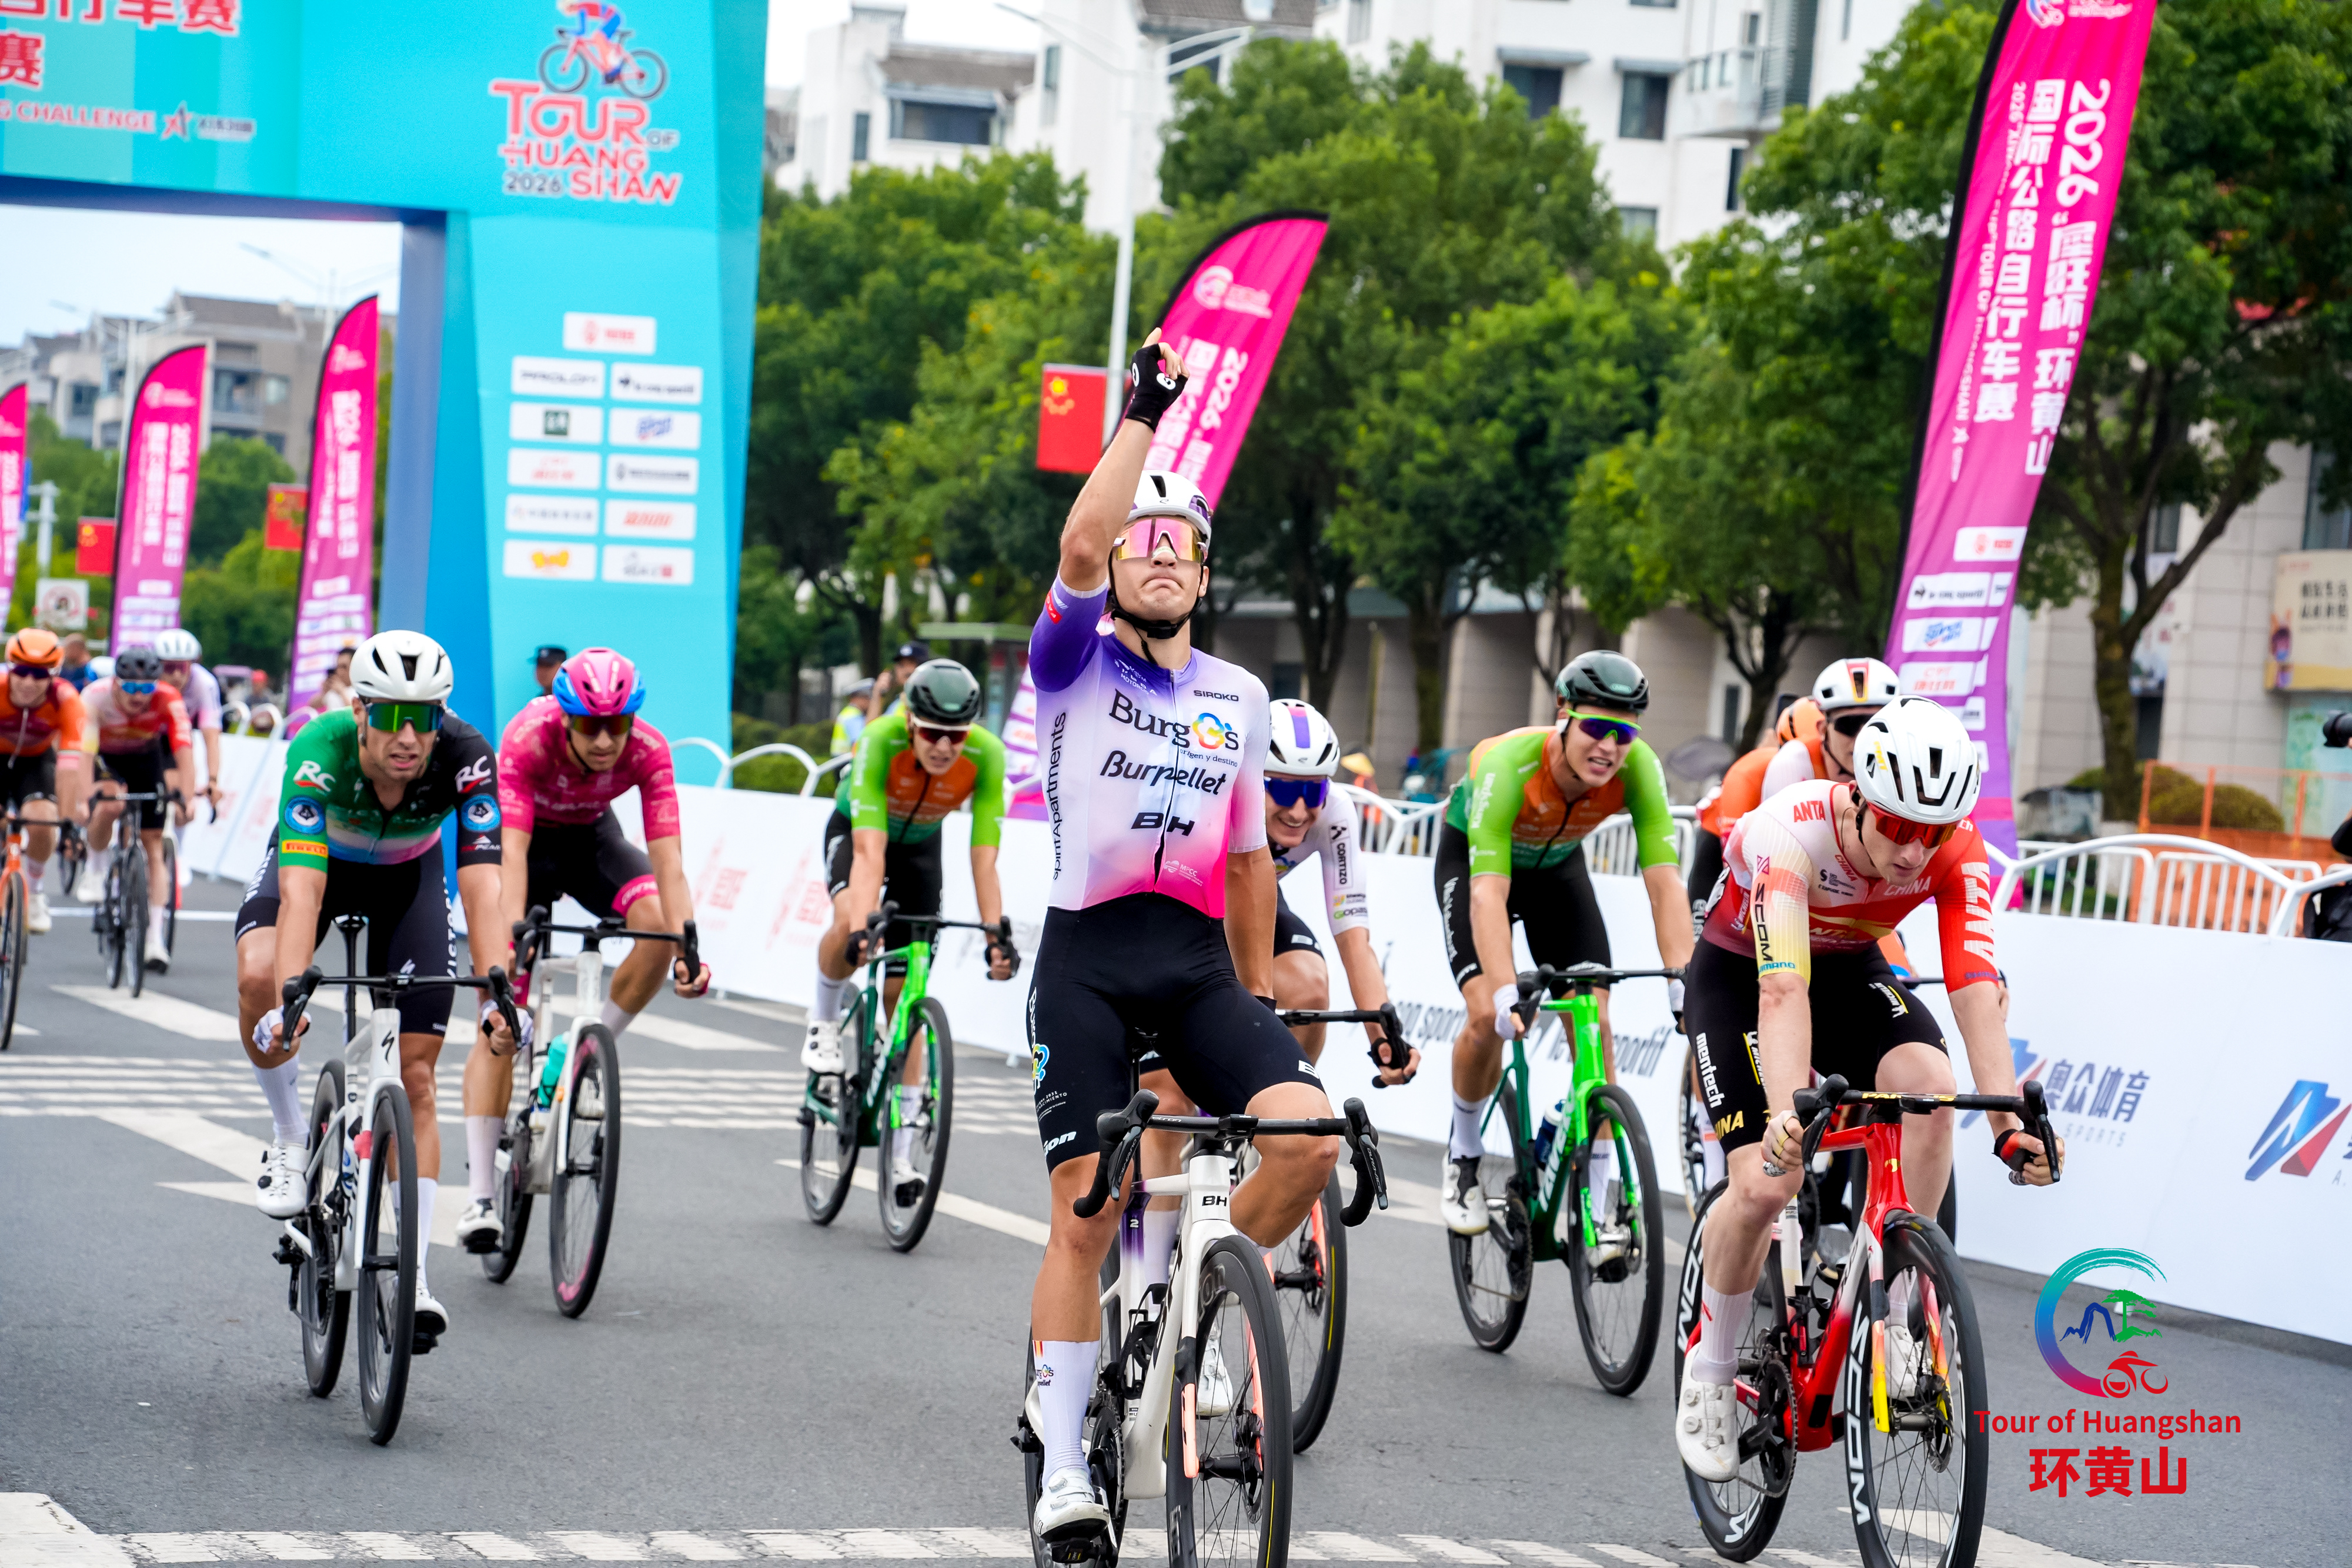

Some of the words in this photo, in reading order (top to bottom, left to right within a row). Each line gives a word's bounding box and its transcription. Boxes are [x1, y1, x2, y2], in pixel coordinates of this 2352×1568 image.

[18, 102, 155, 131] CHALLENGE
[492, 81, 647, 144] TOUR
[648, 131, 677, 147] OF
[502, 142, 646, 172] HUANG
[505, 172, 562, 193] 2026
[570, 168, 679, 202] SHAN
[1194, 690, 1239, 702] SIROKO
[1180, 748, 1204, 760] origen
[1212, 755, 1238, 767] destino
[1100, 750, 1227, 795] Burpellet
[1131, 812, 1195, 836] BH
[1793, 801, 1826, 823] ANTA
[1180, 864, 1198, 877] MPCC
[1337, 842, 1347, 884] CORTIZO
[1835, 854, 1857, 882] CHINA
[1884, 875, 1932, 896] CHINA
[1696, 1032, 1725, 1108] mentech
[2064, 1124, 2127, 1148] SPORTS
[1202, 1196, 1227, 1207] BH
[1130, 1219, 1139, 1228] 2
